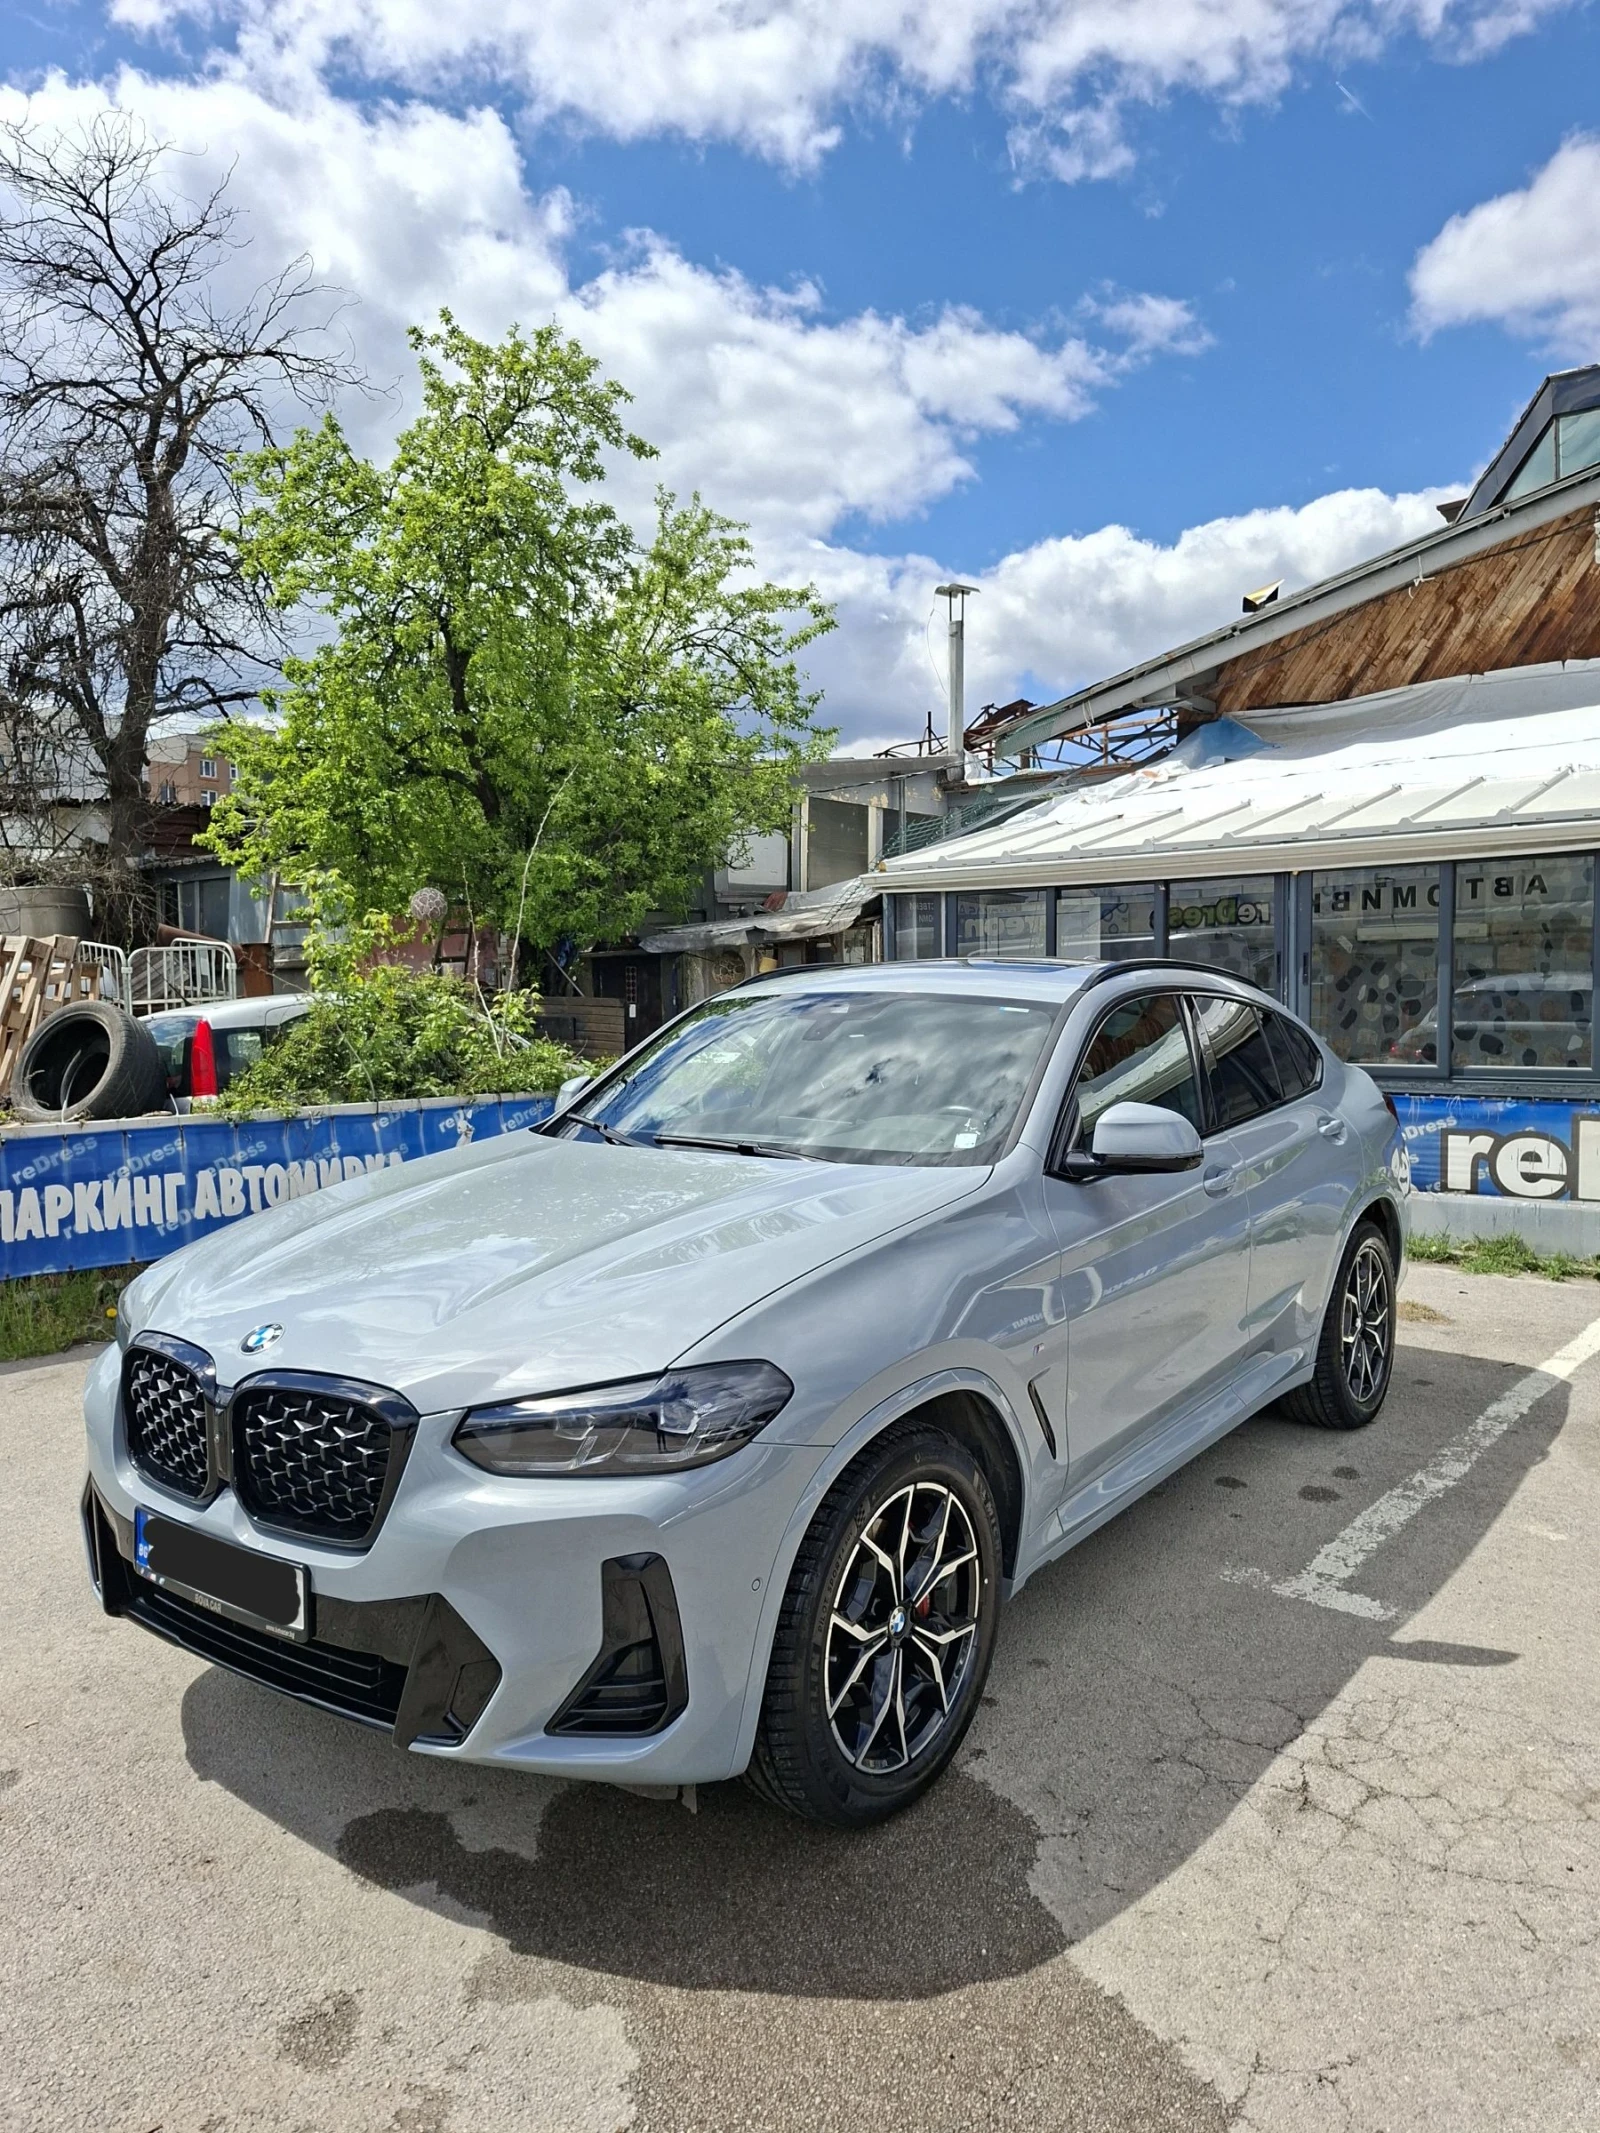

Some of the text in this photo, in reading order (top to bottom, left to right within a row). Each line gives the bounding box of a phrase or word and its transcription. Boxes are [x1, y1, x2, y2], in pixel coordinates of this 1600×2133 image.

[11, 1136, 98, 1185] reDress
[107, 1137, 187, 1182] reDress
[209, 1600, 222, 1615] CAR
[817, 1597, 828, 1633] PILOT
[827, 1553, 842, 1593] SPORT
